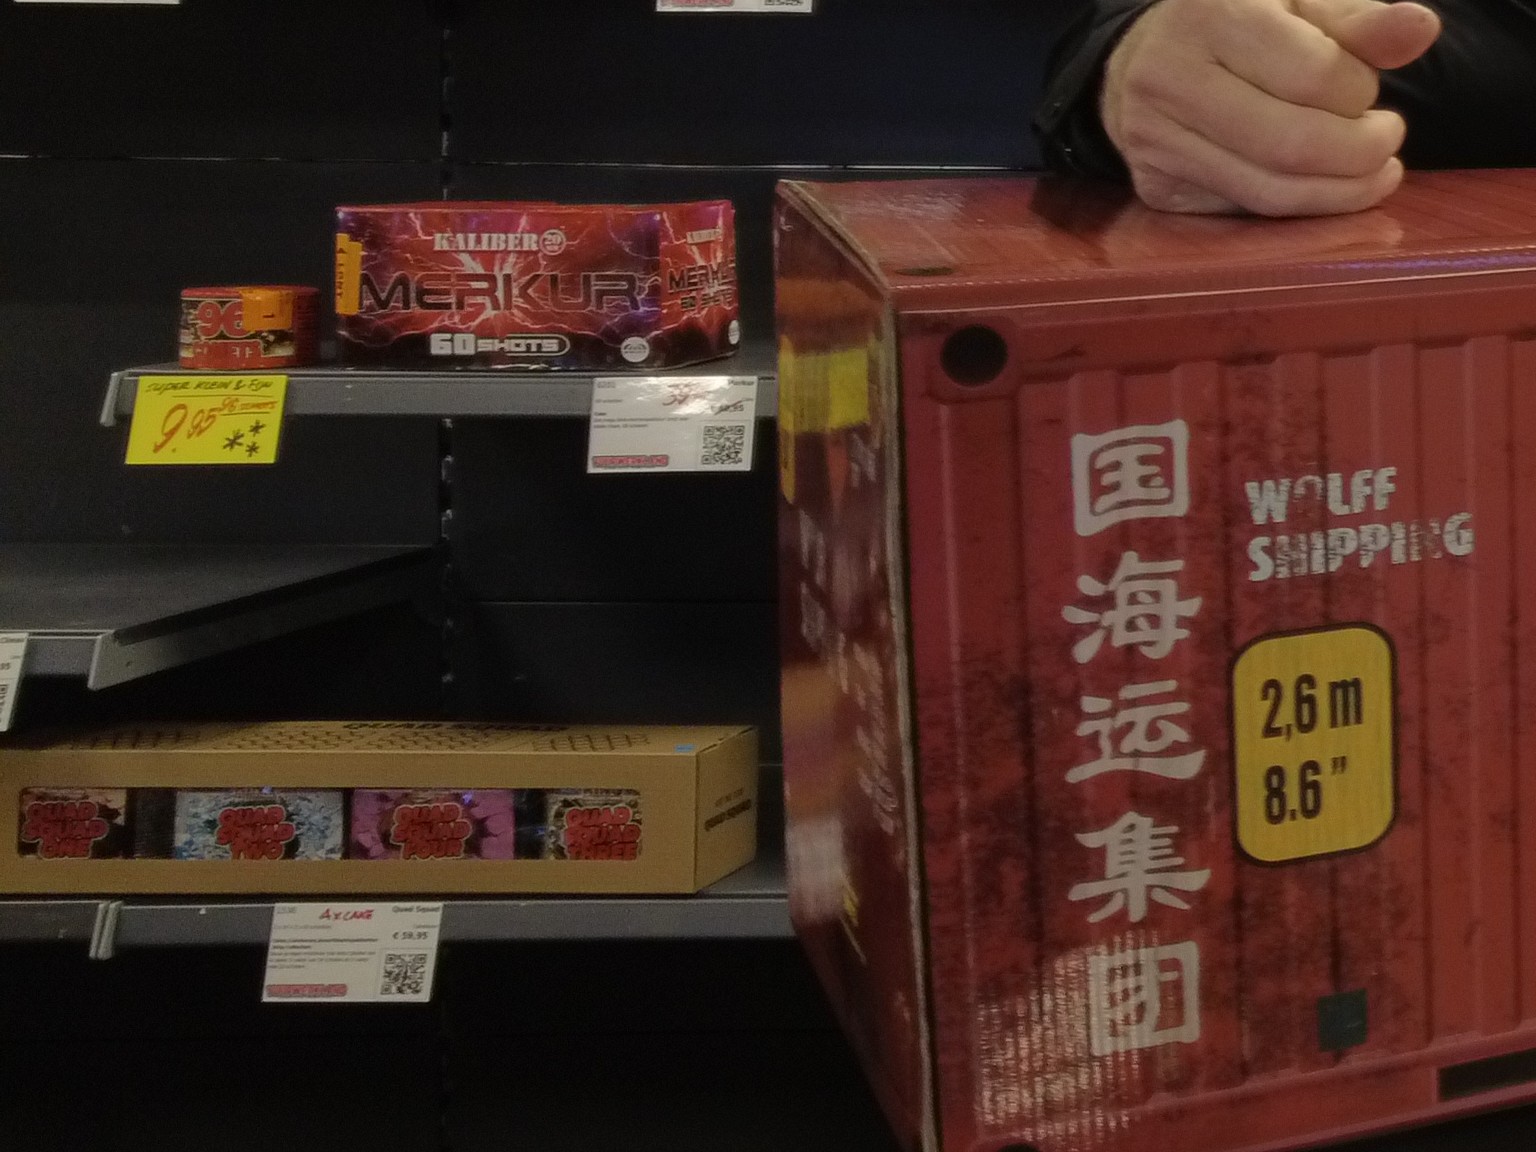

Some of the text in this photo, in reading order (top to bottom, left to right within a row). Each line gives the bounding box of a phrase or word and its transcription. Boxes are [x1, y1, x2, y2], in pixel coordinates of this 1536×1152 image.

[433, 232, 539, 251] KALIBER
[359, 271, 650, 312] MERKUR
[429, 333, 560, 357] 60 SHOTS
[1244, 466, 1399, 526] WOLFF
[1247, 511, 1476, 583] SHIPPING
[1260, 675, 1364, 739] 2,6 m
[1062, 417, 1210, 1057] 国海运集团
[219, 805, 286, 825] QUAD
[394, 803, 462, 824] QUAD
[565, 806, 632, 827] QUAD
